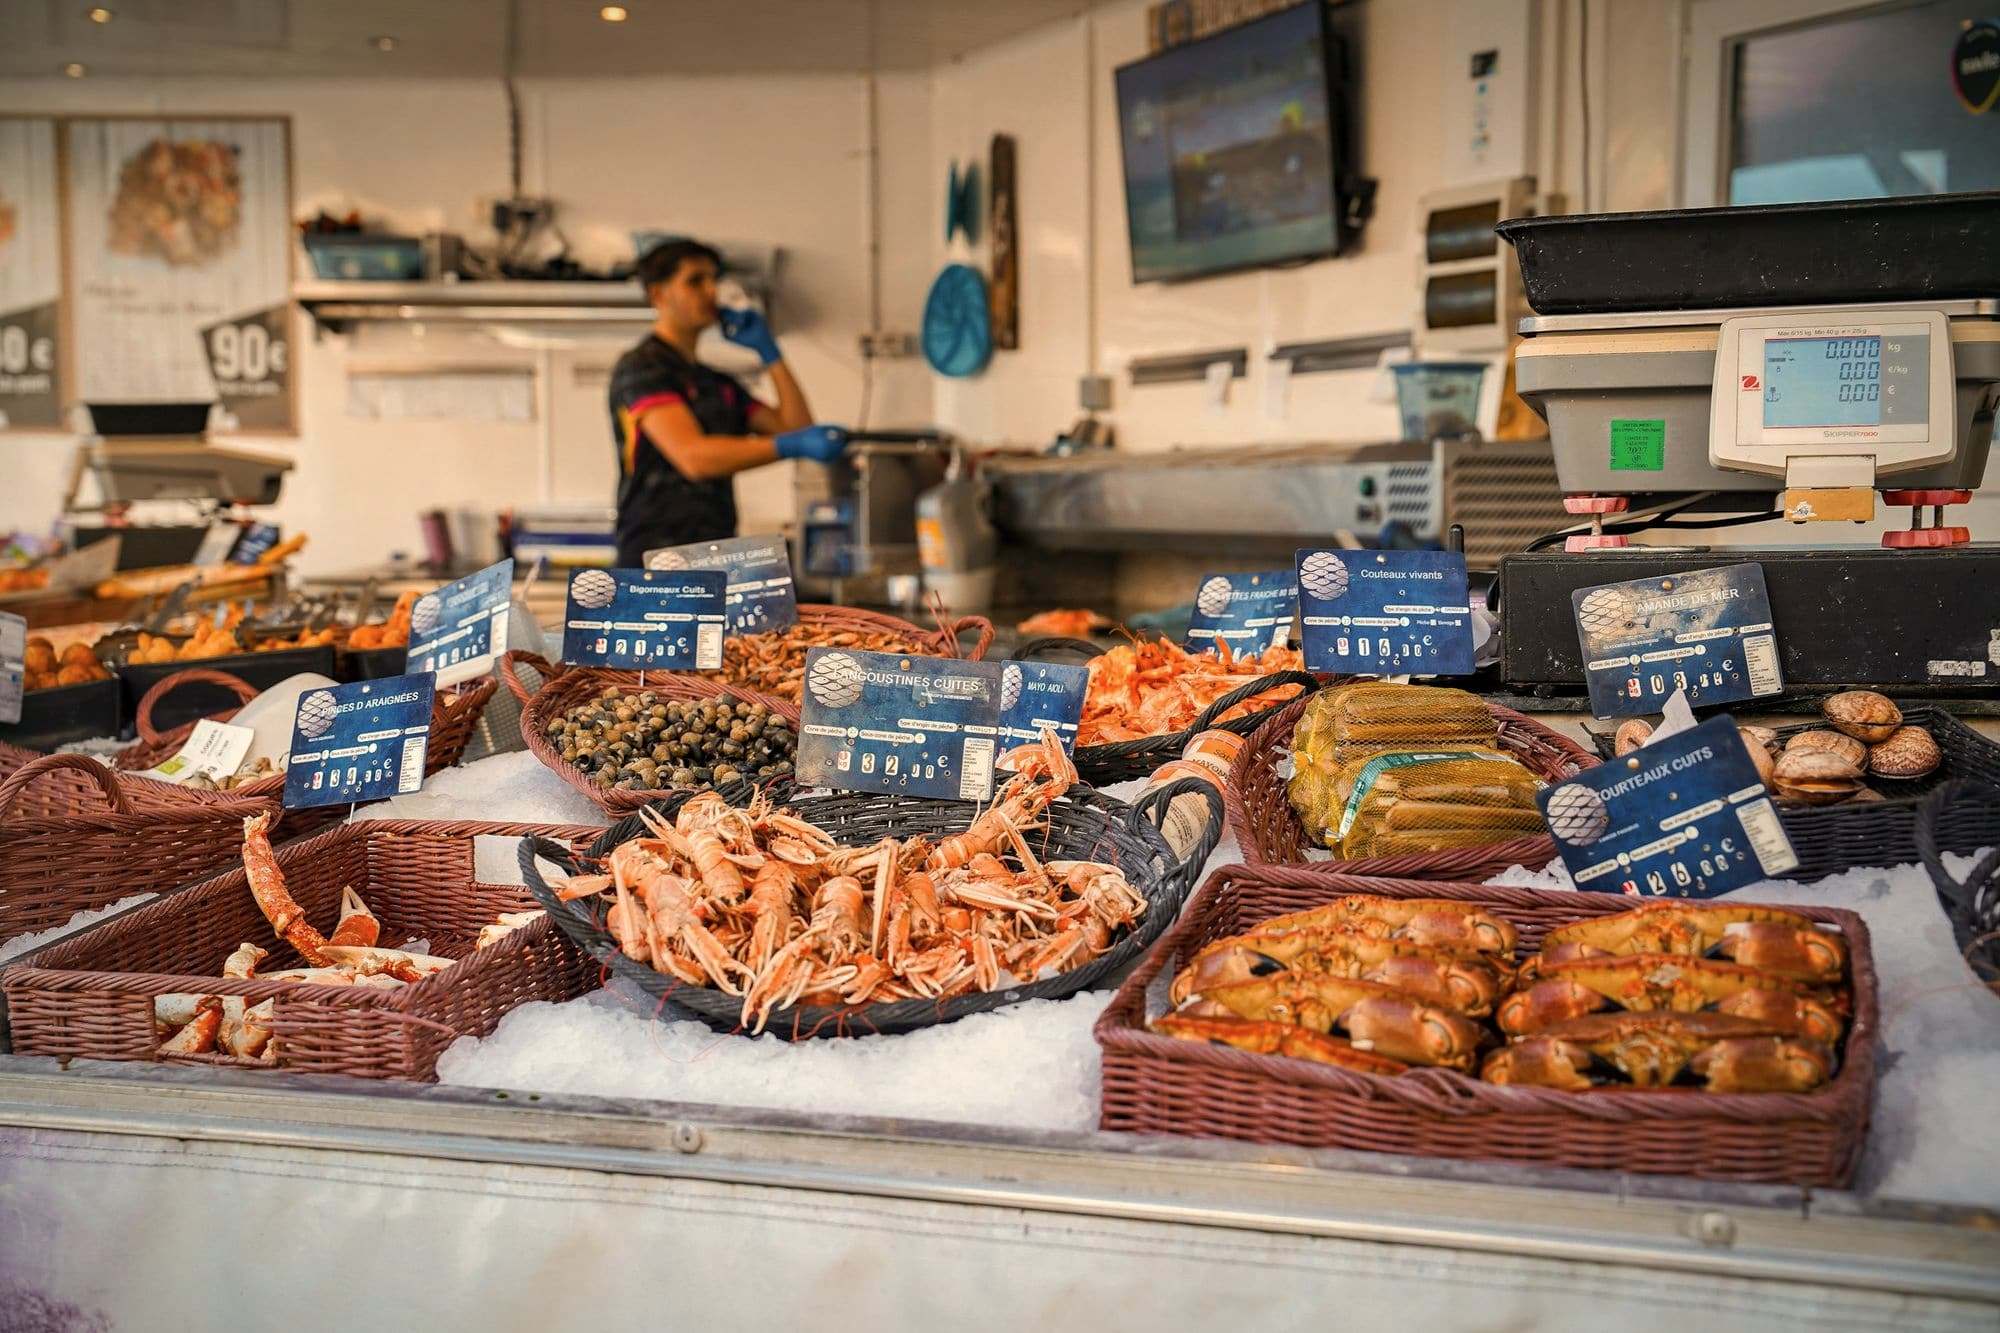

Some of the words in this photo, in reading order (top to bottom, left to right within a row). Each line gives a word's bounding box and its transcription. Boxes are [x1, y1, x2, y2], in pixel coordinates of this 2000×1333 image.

[1888, 343, 1900, 353] kg
[1361, 569, 1406, 580] Couteaux
[1409, 570, 1443, 580] vivants
[629, 584, 680, 595] Bigorneaux
[682, 585, 706, 594] Cuits
[1637, 595, 1690, 613] AMANDE
[1692, 593, 1709, 605] DE
[1711, 588, 1740, 602] MER
[1423, 634, 1432, 646] €
[1722, 659, 1733, 671] €
[833, 669, 930, 687] LANGOUSTINES
[933, 678, 980, 692] CUITES
[1027, 681, 1046, 692] MAYO
[322, 701, 355, 716] PINCES
[365, 691, 419, 709] ARAIGNÉES
[383, 758, 392, 770] €
[937, 755, 948, 768] €
[1672, 746, 1714, 772] CUITS
[1721, 837, 1735, 853] €
